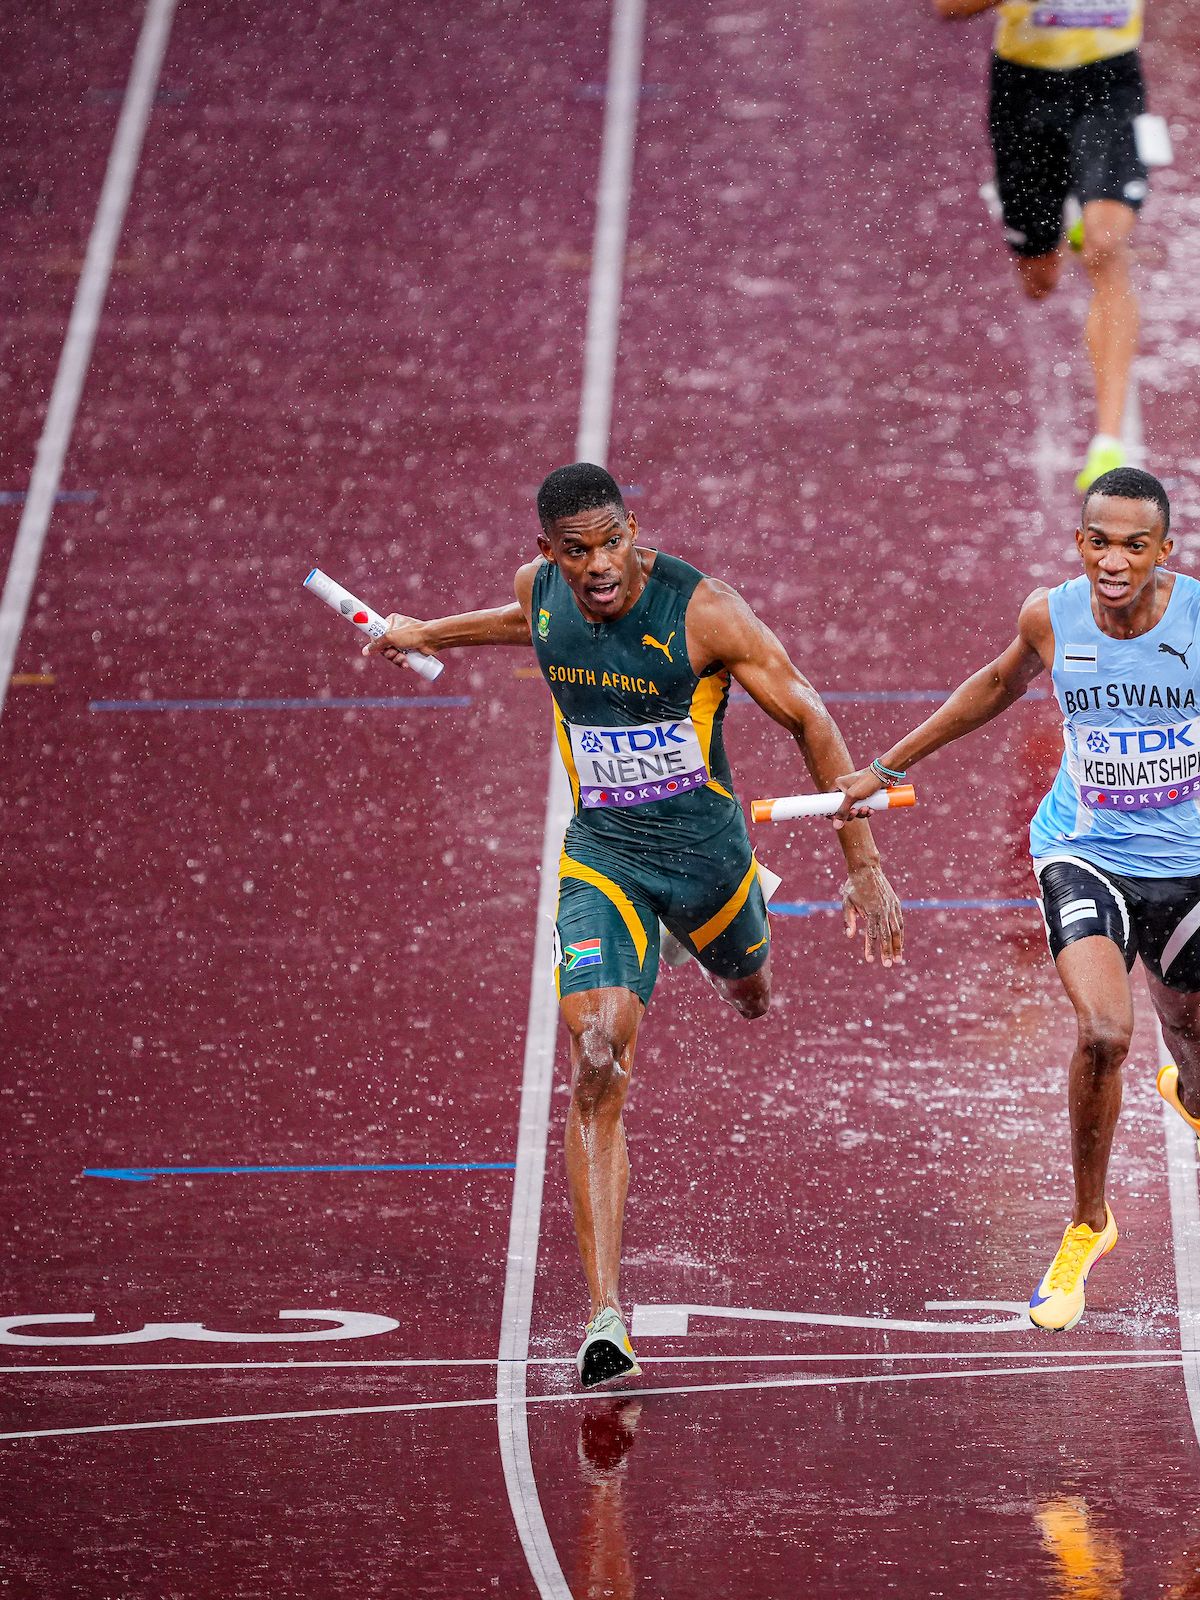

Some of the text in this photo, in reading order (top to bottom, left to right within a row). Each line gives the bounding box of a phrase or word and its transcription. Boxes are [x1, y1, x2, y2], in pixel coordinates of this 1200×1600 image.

[549, 665, 660, 696] SOUTH AFRICA
[1064, 683, 1196, 715] BOTSWANA
[600, 723, 687, 754] TDK
[1109, 723, 1195, 755] TDK
[592, 750, 687, 784] NENE
[1084, 751, 1200, 786] KEBINATSHIPI
